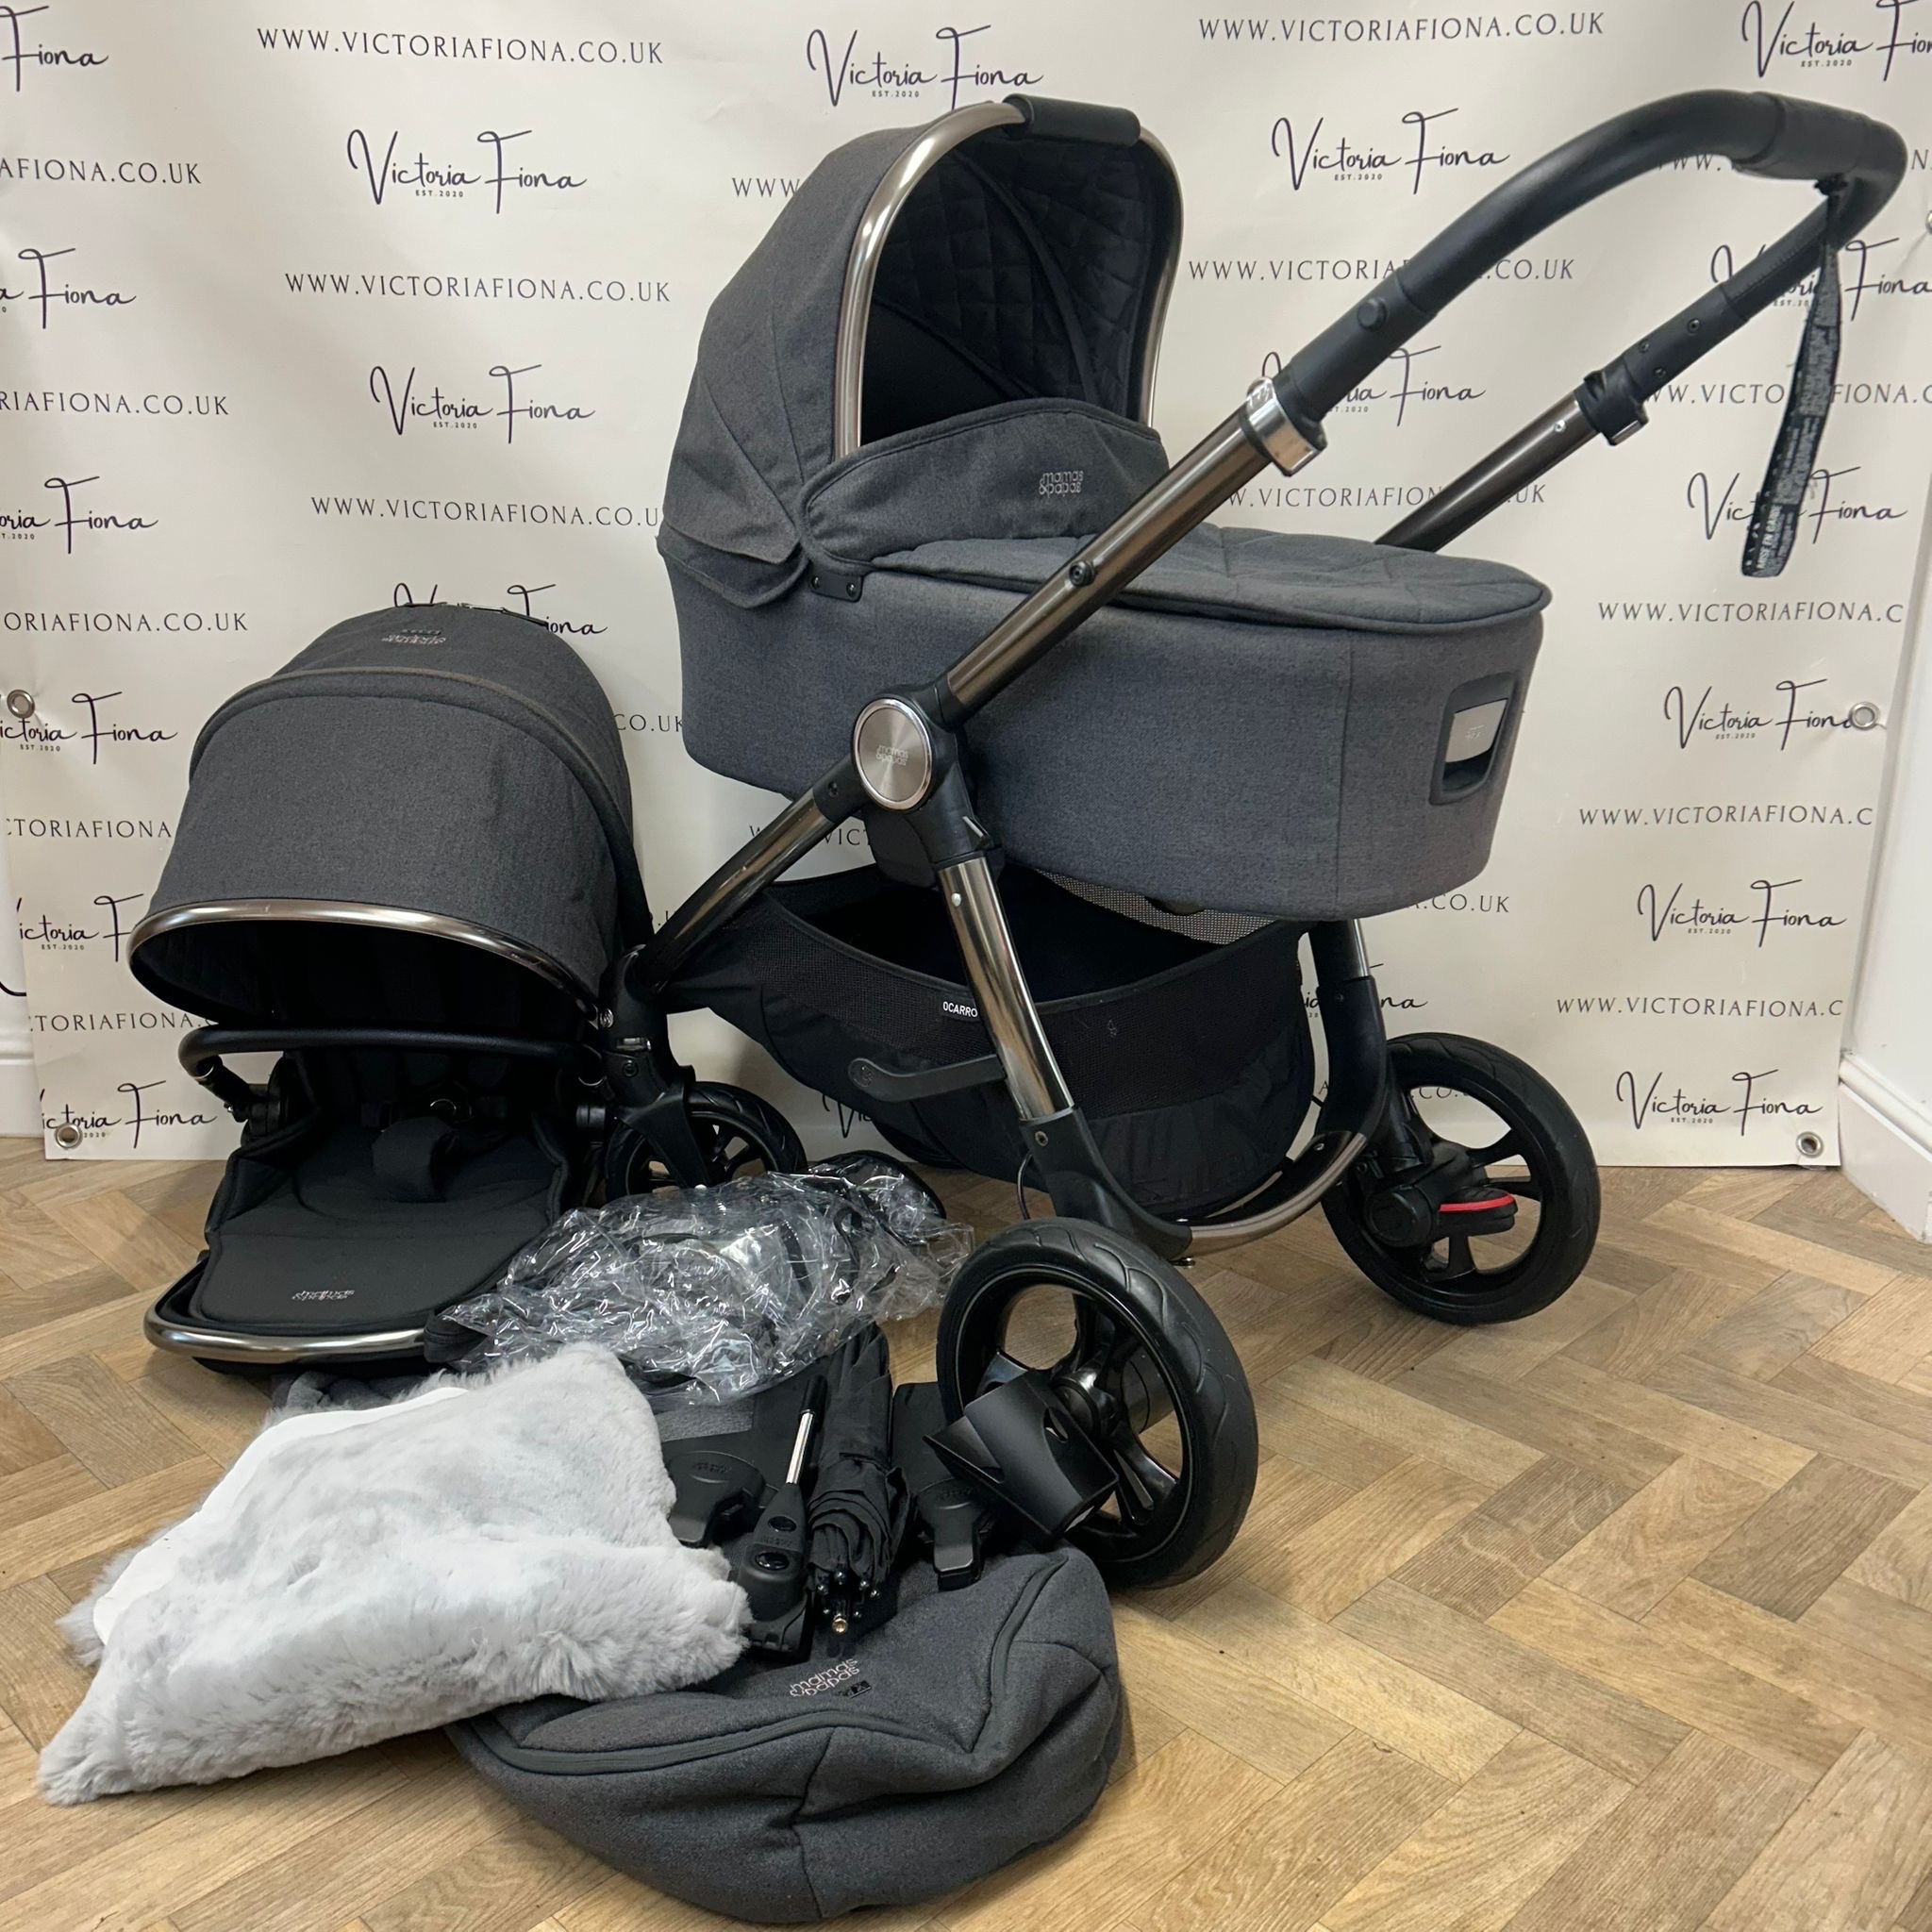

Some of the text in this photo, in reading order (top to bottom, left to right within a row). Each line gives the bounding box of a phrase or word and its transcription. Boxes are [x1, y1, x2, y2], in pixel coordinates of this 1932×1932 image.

[0, 6, 108, 92] Fiona
[258, 27, 662, 64] WWW.VICTORIAFIONA.CO.UK
[1199, 12, 1605, 42] WWW.VICTORIAFIONA.CO.UK
[1741, 0, 1874, 78] Victoria
[807, 24, 1044, 110] Victoria Fiona
[872, 90, 920, 98] EST.2020
[0, 158, 202, 185] AFIONA.CO.UK
[347, 128, 588, 215] Victoria Fiona
[1271, 108, 1510, 194] Victoria Fiona
[415, 190, 464, 198] EST.2020
[1333, 173, 1384, 182] EST.2020
[18, 247, 137, 329] Fiona
[285, 274, 671, 303] WWW.VICTORIAFIONA.CO.UK
[1844, 237, 1932, 323] Fiona
[370, 363, 596, 443] Victoria Fiona
[432, 421, 477, 429] EST.2020
[1042, 470, 1085, 484] mamas
[44, 475, 158, 555] Fiona
[311, 496, 659, 527] WWW.VICTORIAFIONA.CO.U
[1810, 465, 1908, 544] Fiona
[4, 611, 248, 632] ORIAFIONA.CO.UK
[1598, 601, 1904, 624] WWW.VICTORIAFIONA.C
[72, 691, 178, 765] Fiona
[1664, 686, 1774, 750] Victoria
[1579, 805, 1874, 826] WWW.VICTORIAFIONA.C
[17, 897, 99, 941] ictoria
[1638, 878, 1848, 948] Victoria Fiona
[942, 1001, 978, 1018] OCARRO
[1557, 996, 1843, 1018] WWW.VICTORIAFIONA.C
[41, 1079, 218, 1149] ictoria Fiona
[1616, 1068, 1824, 1137] Victoria Fiona
